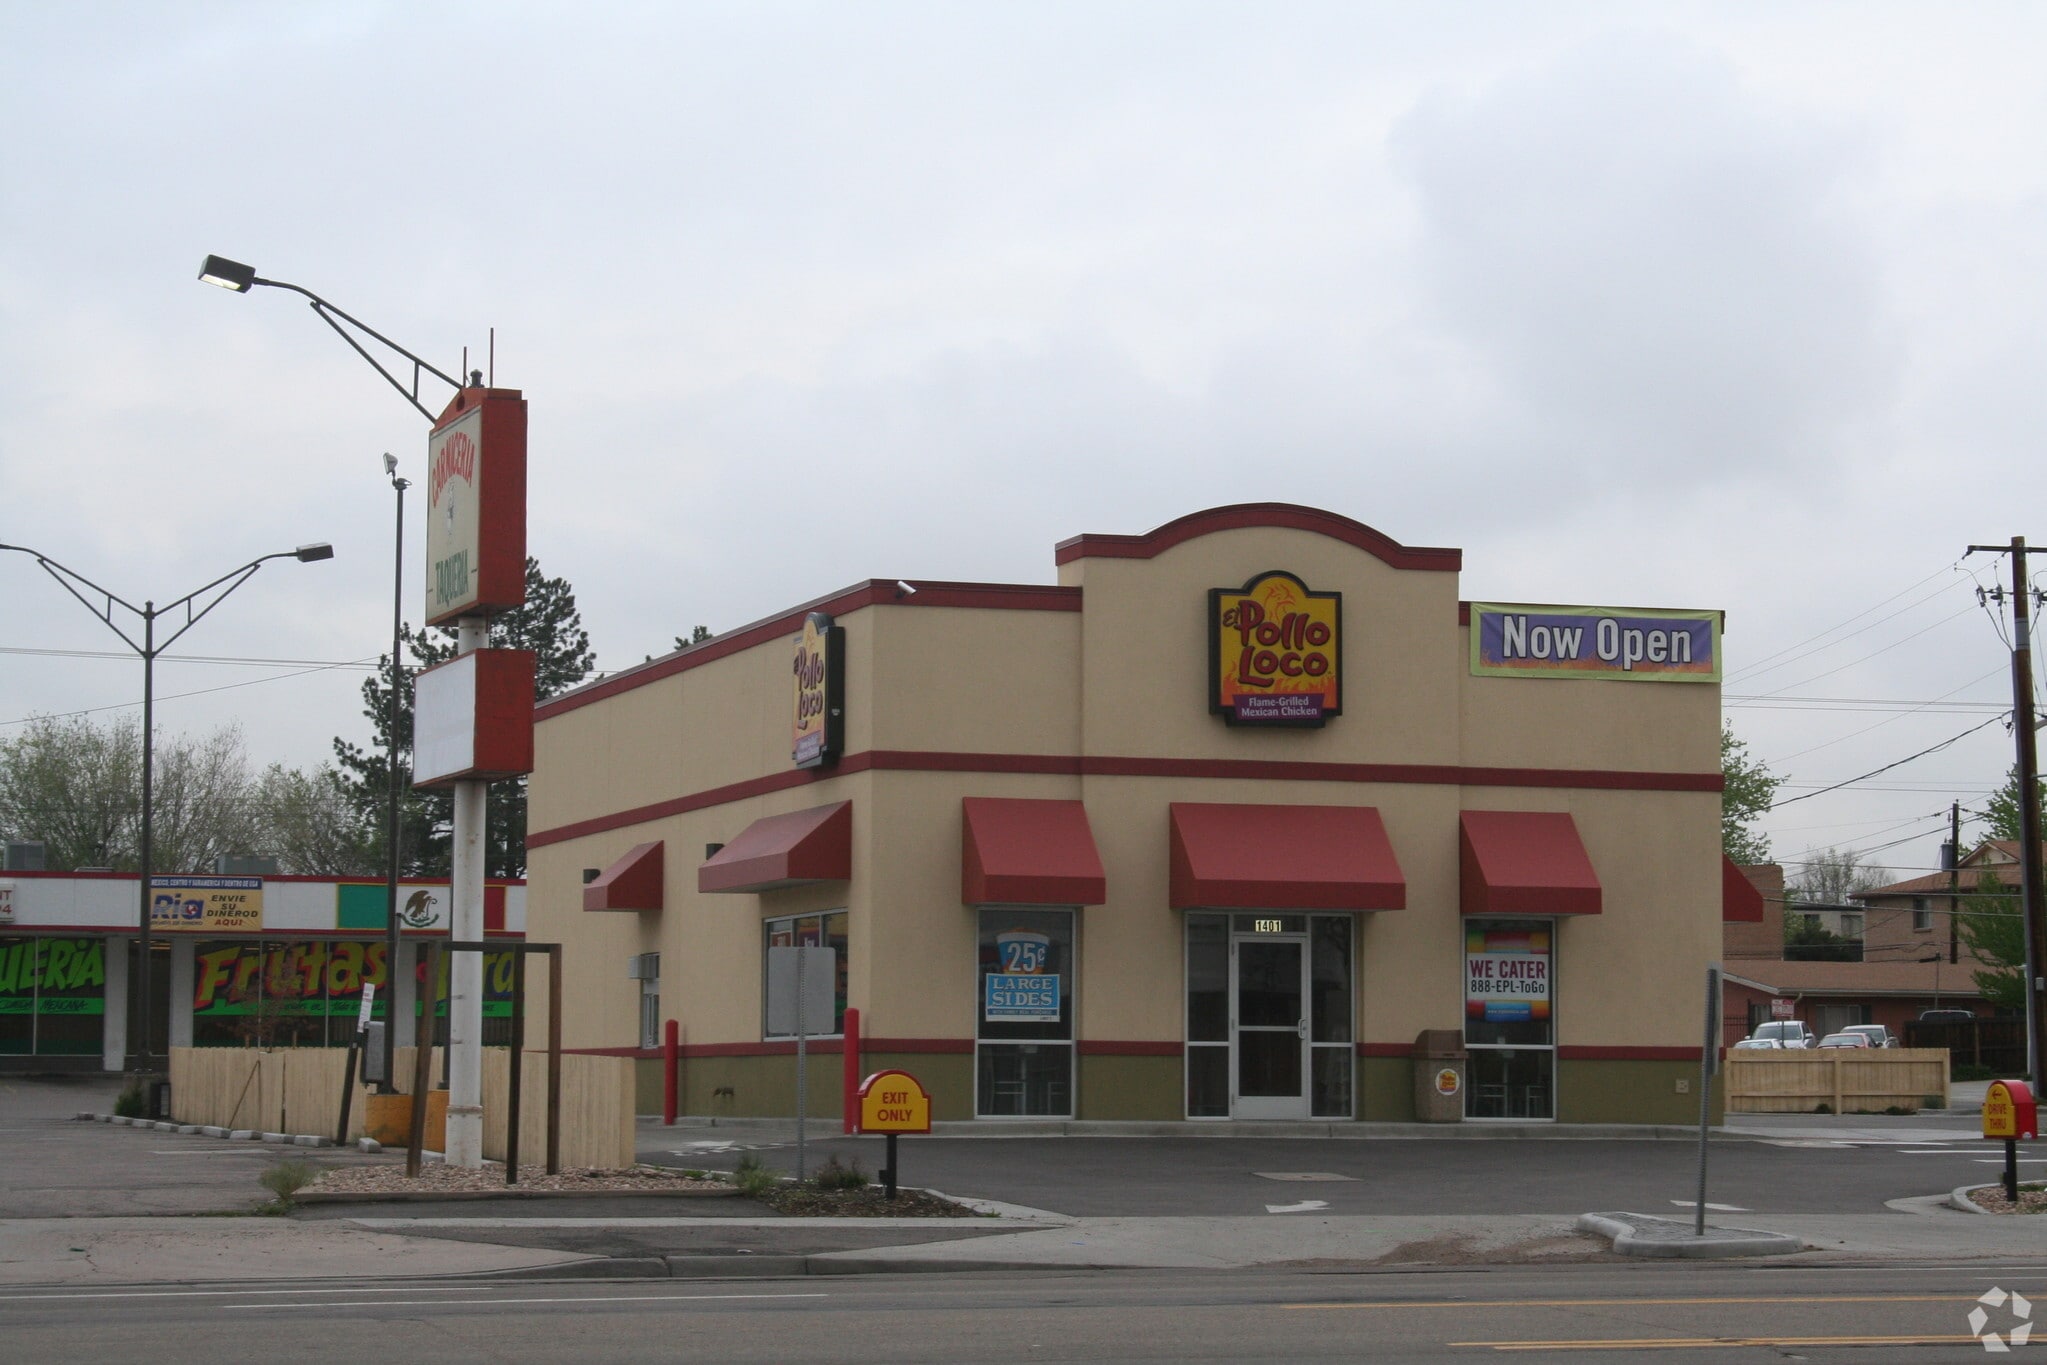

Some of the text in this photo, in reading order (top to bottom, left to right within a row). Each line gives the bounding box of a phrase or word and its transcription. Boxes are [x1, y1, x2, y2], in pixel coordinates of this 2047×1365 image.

[436, 549, 469, 607] TAQUERIA
[1238, 600, 1331, 650] Pollo
[1502, 614, 1692, 671] Now Open
[798, 646, 824, 691] Pollo
[1238, 646, 1329, 688] Loco
[797, 690, 823, 730] Loco
[1249, 697, 1309, 707] Flame-Grilled
[1241, 706, 1318, 717] Mexican Chicken
[152, 893, 204, 919] Ria
[211, 895, 246, 903] ENVIE
[221, 903, 236, 911] SU
[1257, 920, 1281, 932] 1401
[1007, 943, 1046, 972] 25¢
[194, 941, 387, 1009] Frutas
[1469, 960, 1546, 979] WE CATER
[993, 978, 1053, 990] LARGE
[992, 991, 1053, 1007] SIDES
[882, 1092, 909, 1105] EXIT
[877, 1109, 912, 1122] ONLY
[1988, 1103, 2007, 1115] DRIVE
[1989, 1118, 2007, 1130] THRU
